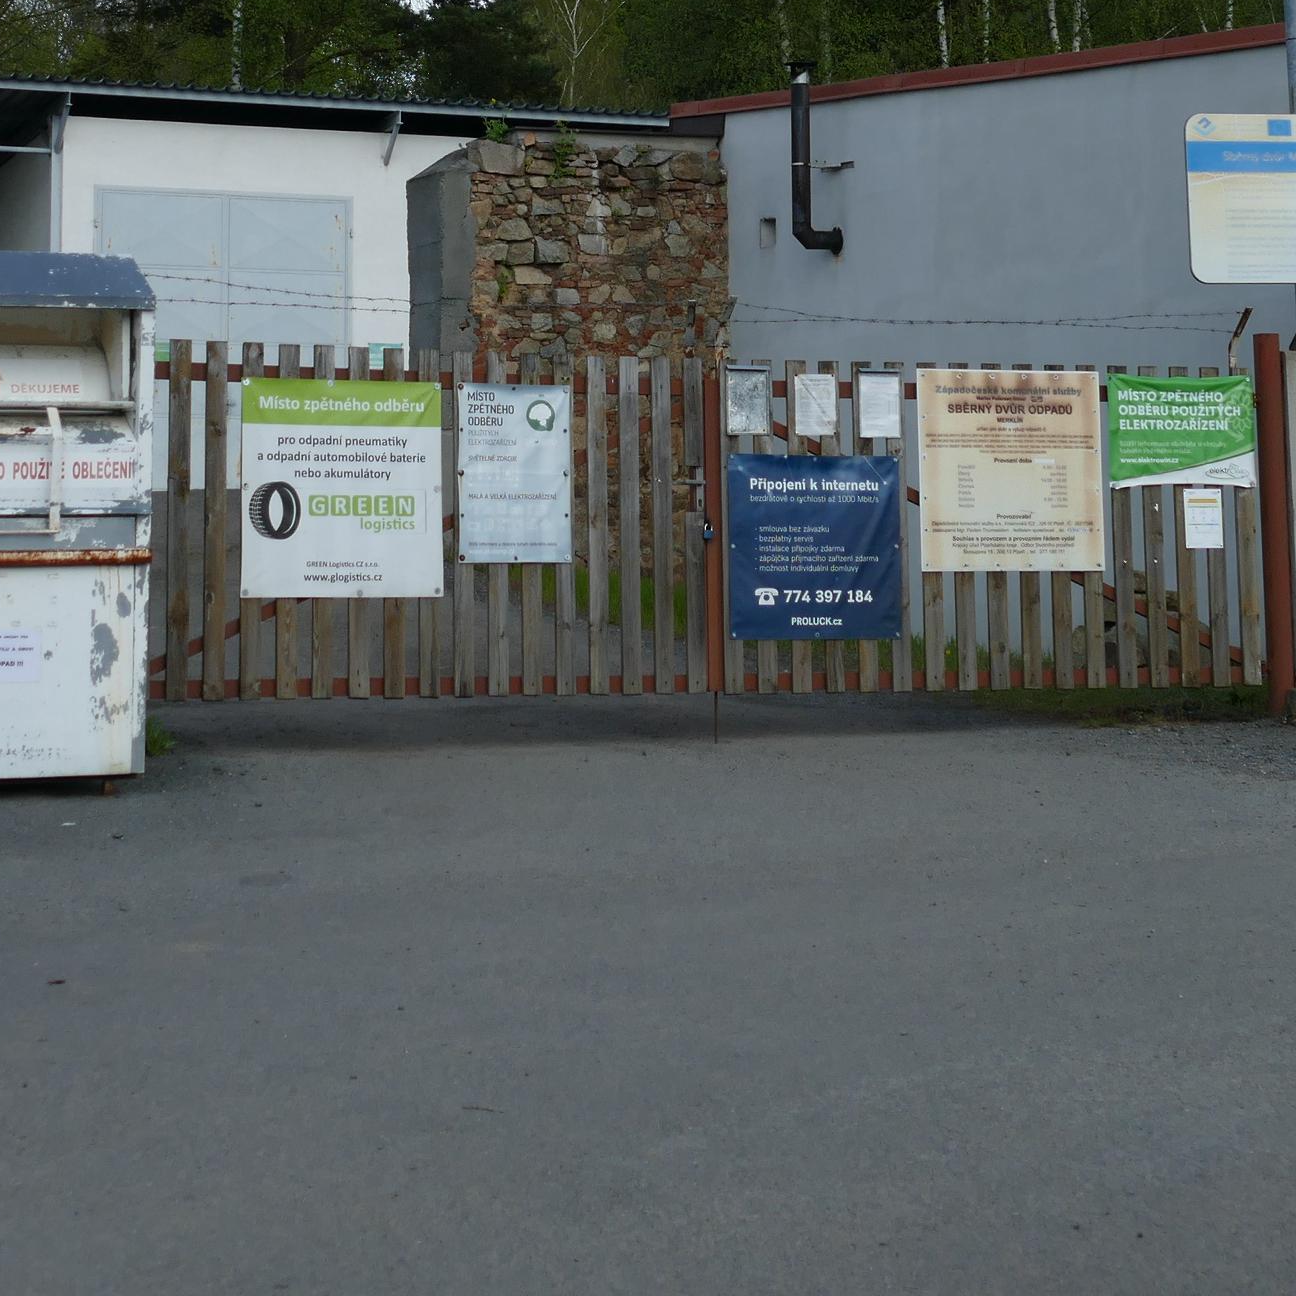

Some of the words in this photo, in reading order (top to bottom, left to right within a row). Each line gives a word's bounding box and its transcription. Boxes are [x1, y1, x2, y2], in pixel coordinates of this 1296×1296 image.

[10, 382, 80, 394] DĚKUJEME
[935, 386, 998, 396] Západočeské
[467, 390, 496, 402] MÍSTO
[1118, 388, 1157, 402] MÍSTO
[1160, 390, 1223, 402] ZPĚTNÉHO
[259, 396, 300, 410] Místo
[304, 397, 370, 413] zpětného
[374, 398, 425, 412] odběru
[467, 403, 515, 414] ZPĚTNÉHO
[947, 402, 992, 414] SBĚRNÝ
[995, 402, 1025, 414] DVŮR
[1028, 403, 1072, 415] ODPADŮ
[1118, 403, 1169, 416] ODBĚRU
[1172, 404, 1241, 416] POUŽITÝCH
[467, 415, 503, 426] ODBĚRU
[1119, 417, 1229, 431] ELEKTROZAŘÍZENÍ
[277, 437, 296, 446] pro
[298, 435, 343, 446] odpadní
[345, 436, 408, 448] pneumatiky
[257, 453, 264, 461] a
[267, 451, 311, 462] odpadní
[313, 451, 387, 462] automobilové
[390, 452, 426, 463] baterie
[13, 457, 65, 480] POUŽI
[72, 457, 134, 480] OBLEČENÍ
[294, 468, 321, 478] nebo
[324, 468, 391, 480] akumulátory
[749, 478, 806, 492] Připojení
[810, 479, 818, 490] k
[822, 479, 879, 491] internetu
[796, 495, 826, 504] rychlosti
[838, 495, 855, 503] 1000
[857, 495, 879, 503] Mbit/s
[310, 496, 414, 516] GREEN
[360, 517, 415, 533] logistics
[759, 525, 787, 533] smlouva
[789, 525, 801, 533] bez
[803, 525, 830, 533] závazku
[759, 535, 792, 543] bezplatný
[329, 561, 355, 569] Logistics
[759, 564, 789, 572] možnost
[790, 564, 829, 572] individuální
[830, 564, 859, 573] domluvy
[304, 572, 383, 583] www.glogistics.cz
[783, 590, 811, 603] 774
[815, 590, 842, 603] 397
[847, 590, 873, 603] 184
[791, 617, 843, 626] PROLUCK.cz
